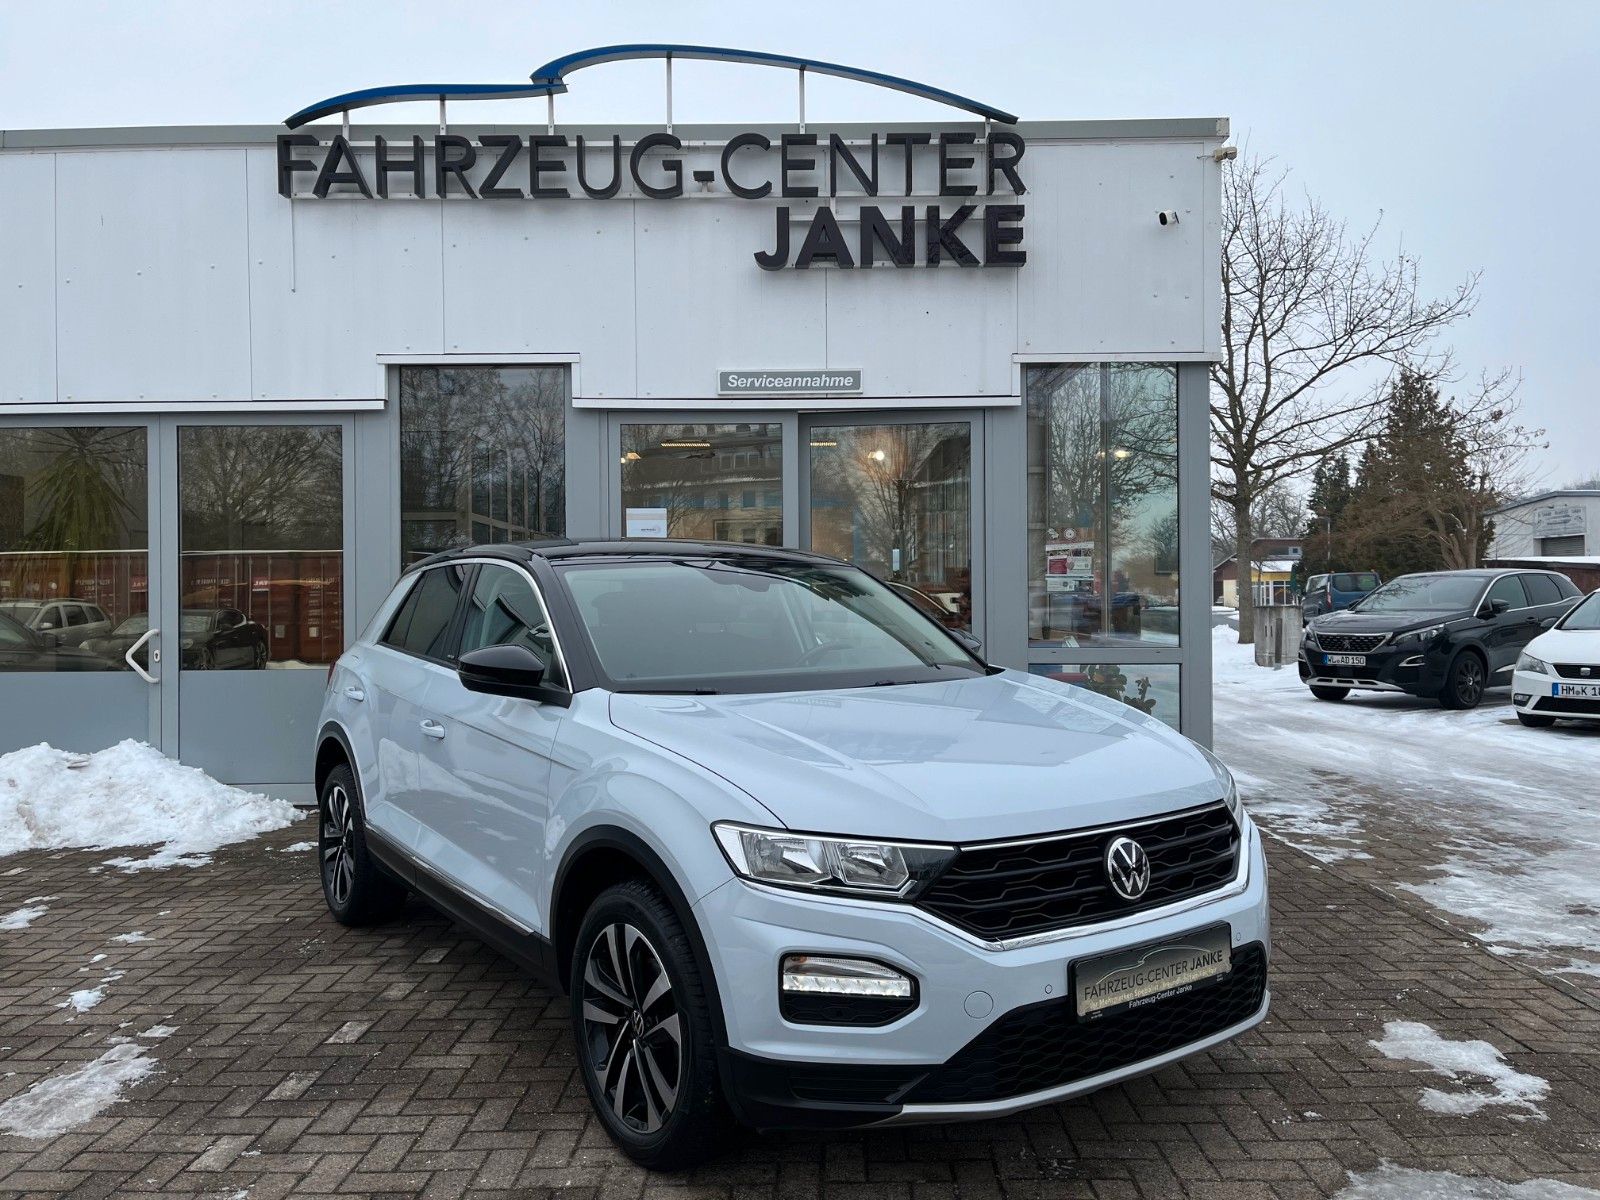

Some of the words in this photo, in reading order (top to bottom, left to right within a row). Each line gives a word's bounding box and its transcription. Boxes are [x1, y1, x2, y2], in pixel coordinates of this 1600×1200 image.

[277, 133, 1026, 200] FAHRZEUG-CENTER
[754, 206, 1026, 271] JANKE
[727, 373, 853, 388] Serviceannahme
[1561, 685, 1575, 695] HM
[1084, 960, 1188, 1001] FAHRZEUG-CENTER
[1190, 949, 1223, 971] JANKE
[1129, 989, 1175, 1009] Fahrzeug-Center
[1176, 984, 1192, 996] Janke
